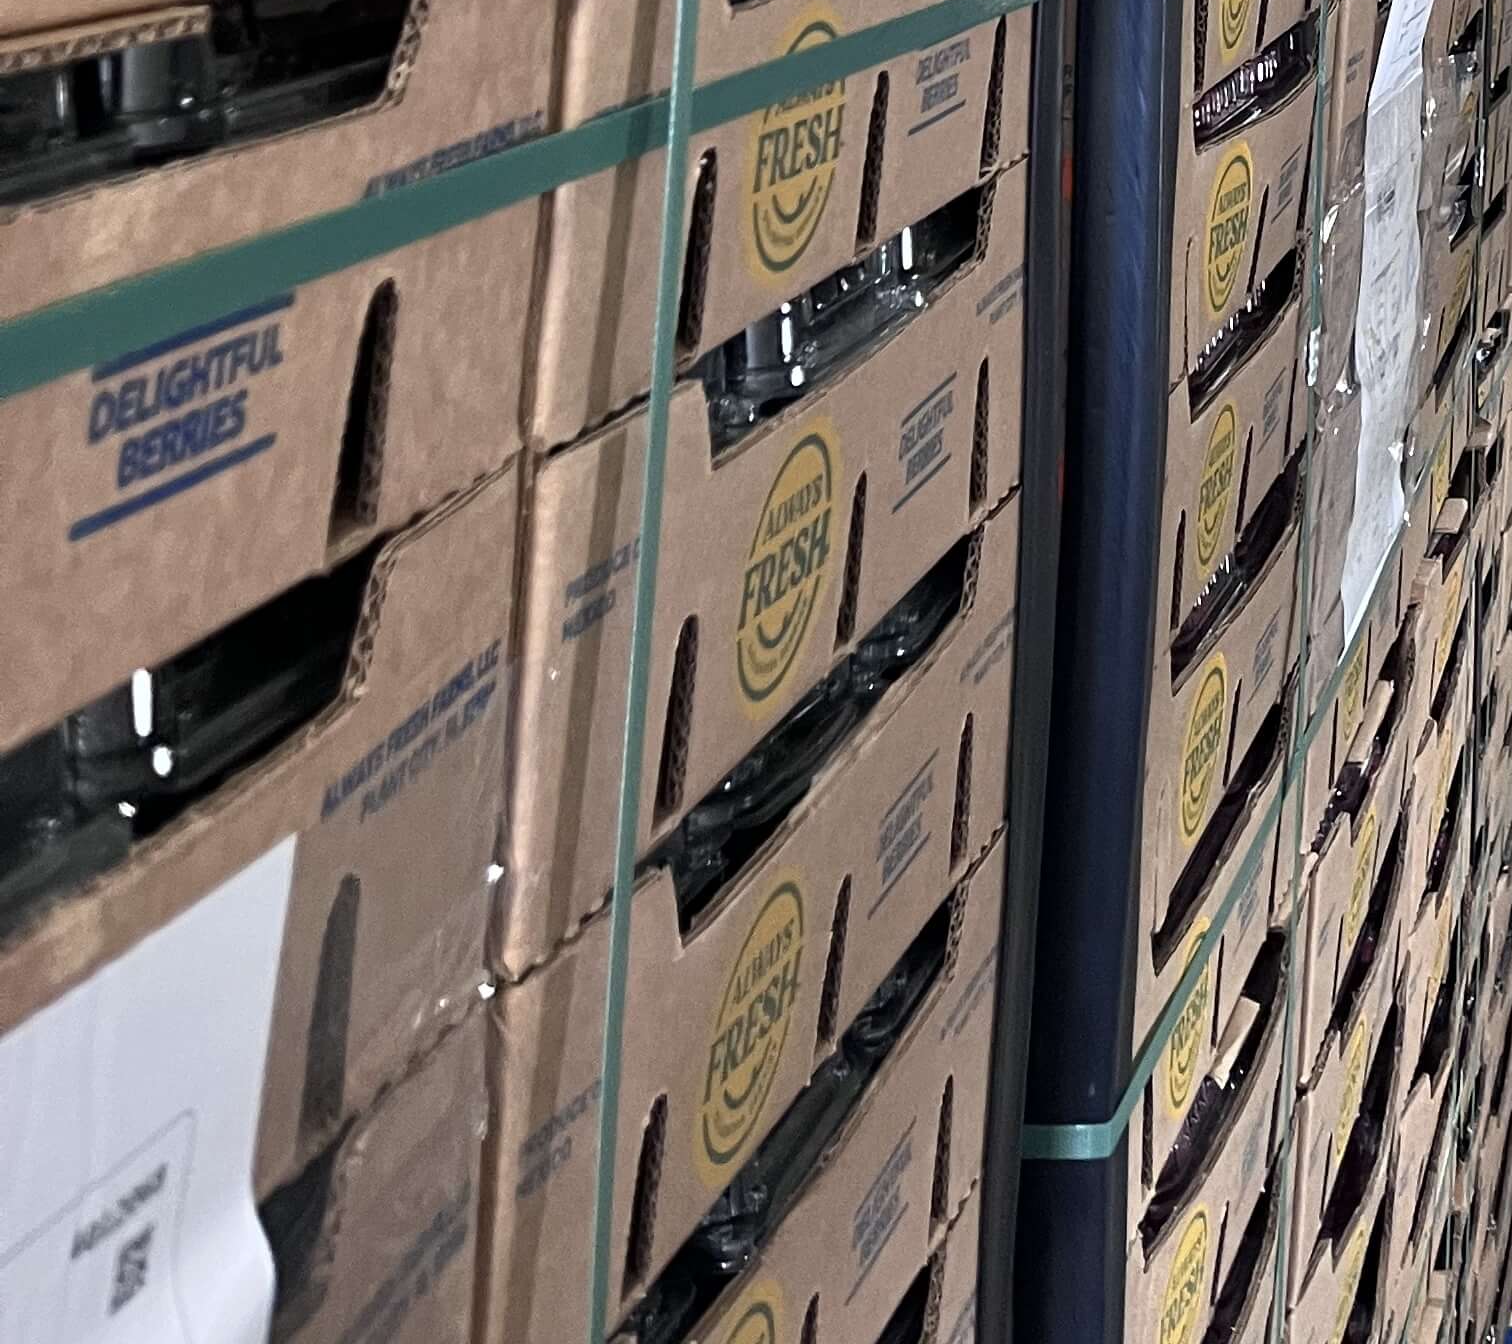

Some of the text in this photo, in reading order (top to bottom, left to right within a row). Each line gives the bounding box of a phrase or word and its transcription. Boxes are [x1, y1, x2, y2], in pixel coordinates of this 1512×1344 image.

[753, 103, 846, 194] FRESH
[88, 323, 284, 445] DELIGHTFUL
[116, 389, 250, 491] BERRIES
[763, 474, 825, 546] ALWAYS
[739, 507, 832, 631] FRESH
[730, 917, 796, 1007] ALWAYS
[704, 946, 801, 1105] FRESH
